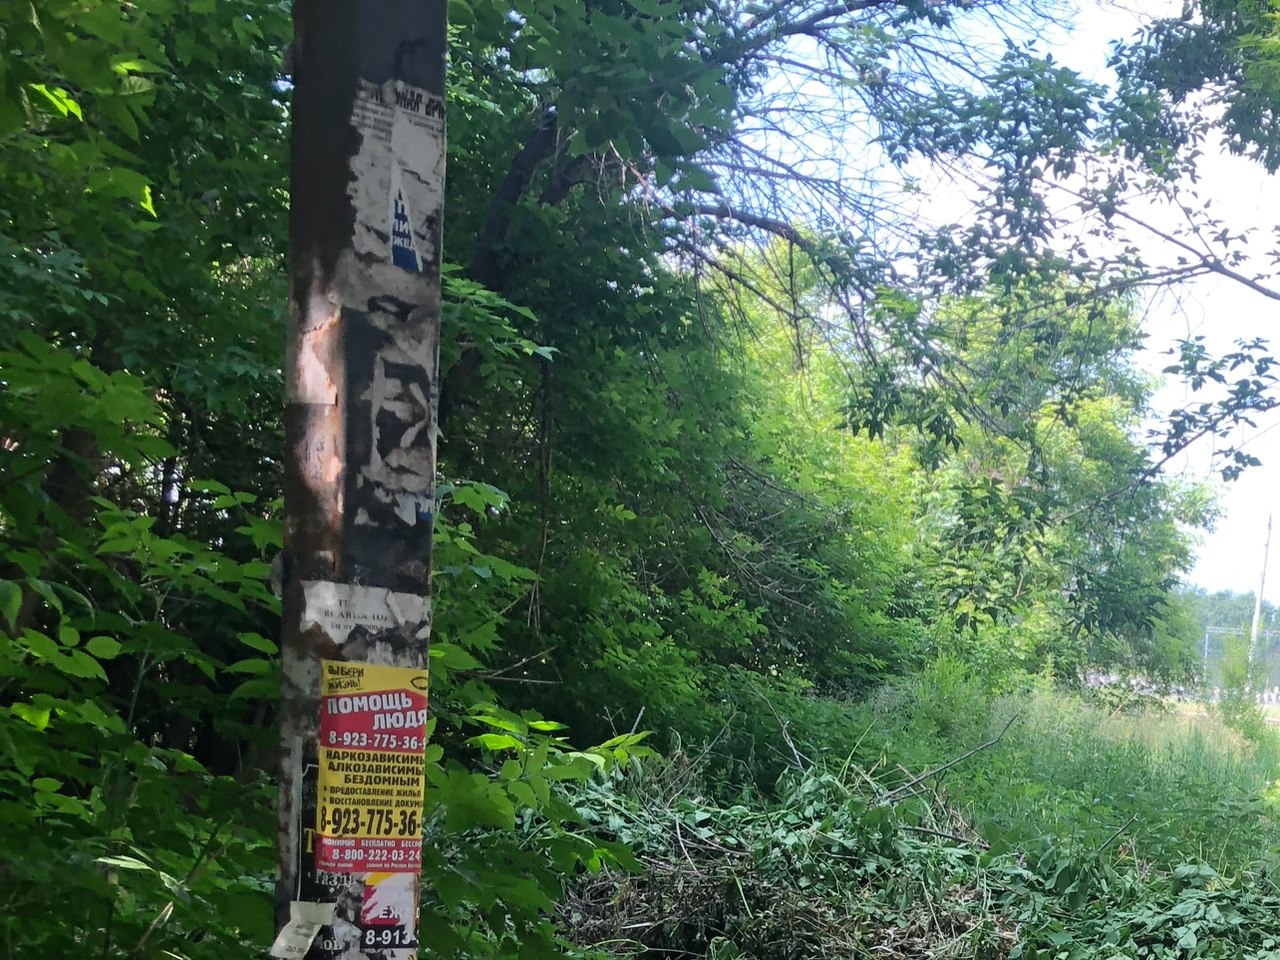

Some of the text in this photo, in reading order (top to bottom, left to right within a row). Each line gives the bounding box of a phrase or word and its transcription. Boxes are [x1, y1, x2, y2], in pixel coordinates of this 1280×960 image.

[327, 665, 364, 678] ВЫБЕРИ
[327, 692, 412, 715] ПОМОЩЬ
[328, 730, 427, 750] 8-923-775-36-
[344, 774, 420, 787] БЕЗДОМНЫМ
[330, 785, 422, 798] ПРЕДОСТАВЛЕНИЕ ЖИЛЬЯ
[329, 797, 393, 808] ВОССТАНОВЛЕНИЕ
[365, 929, 419, 945] 8-913-
